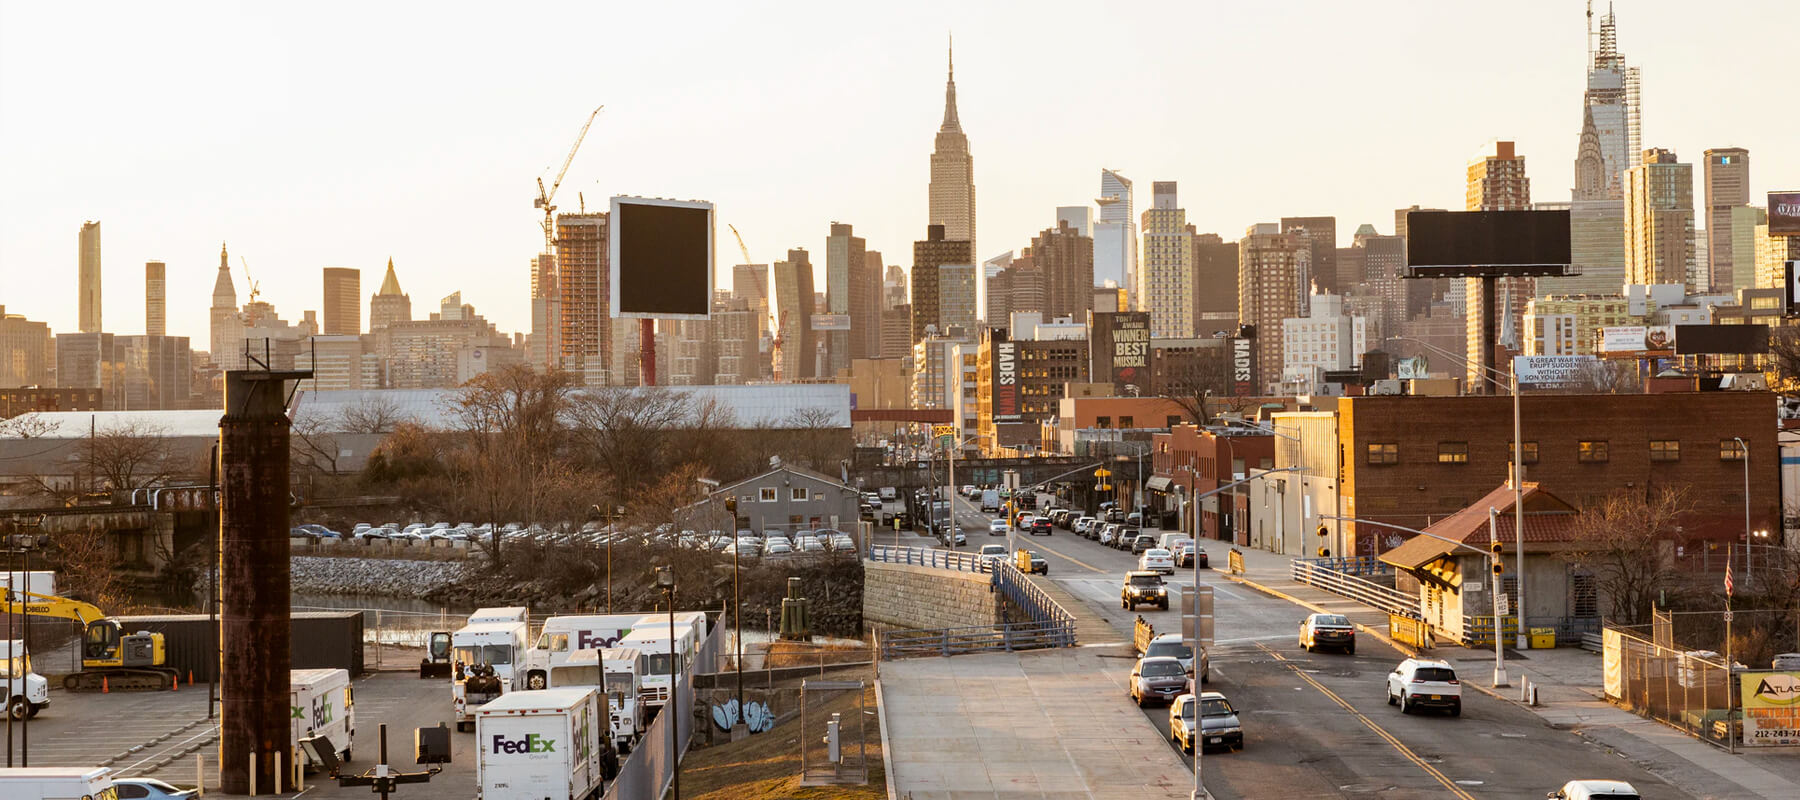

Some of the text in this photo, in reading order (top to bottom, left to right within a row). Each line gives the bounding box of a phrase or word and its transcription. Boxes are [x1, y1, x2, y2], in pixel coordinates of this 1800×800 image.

[1112, 328, 1150, 342] WINNER!
[1116, 342, 1148, 356] BEST
[1114, 356, 1146, 368] MUSICAL
[578, 629, 632, 649] Fed
[493, 734, 556, 754] FedEx
